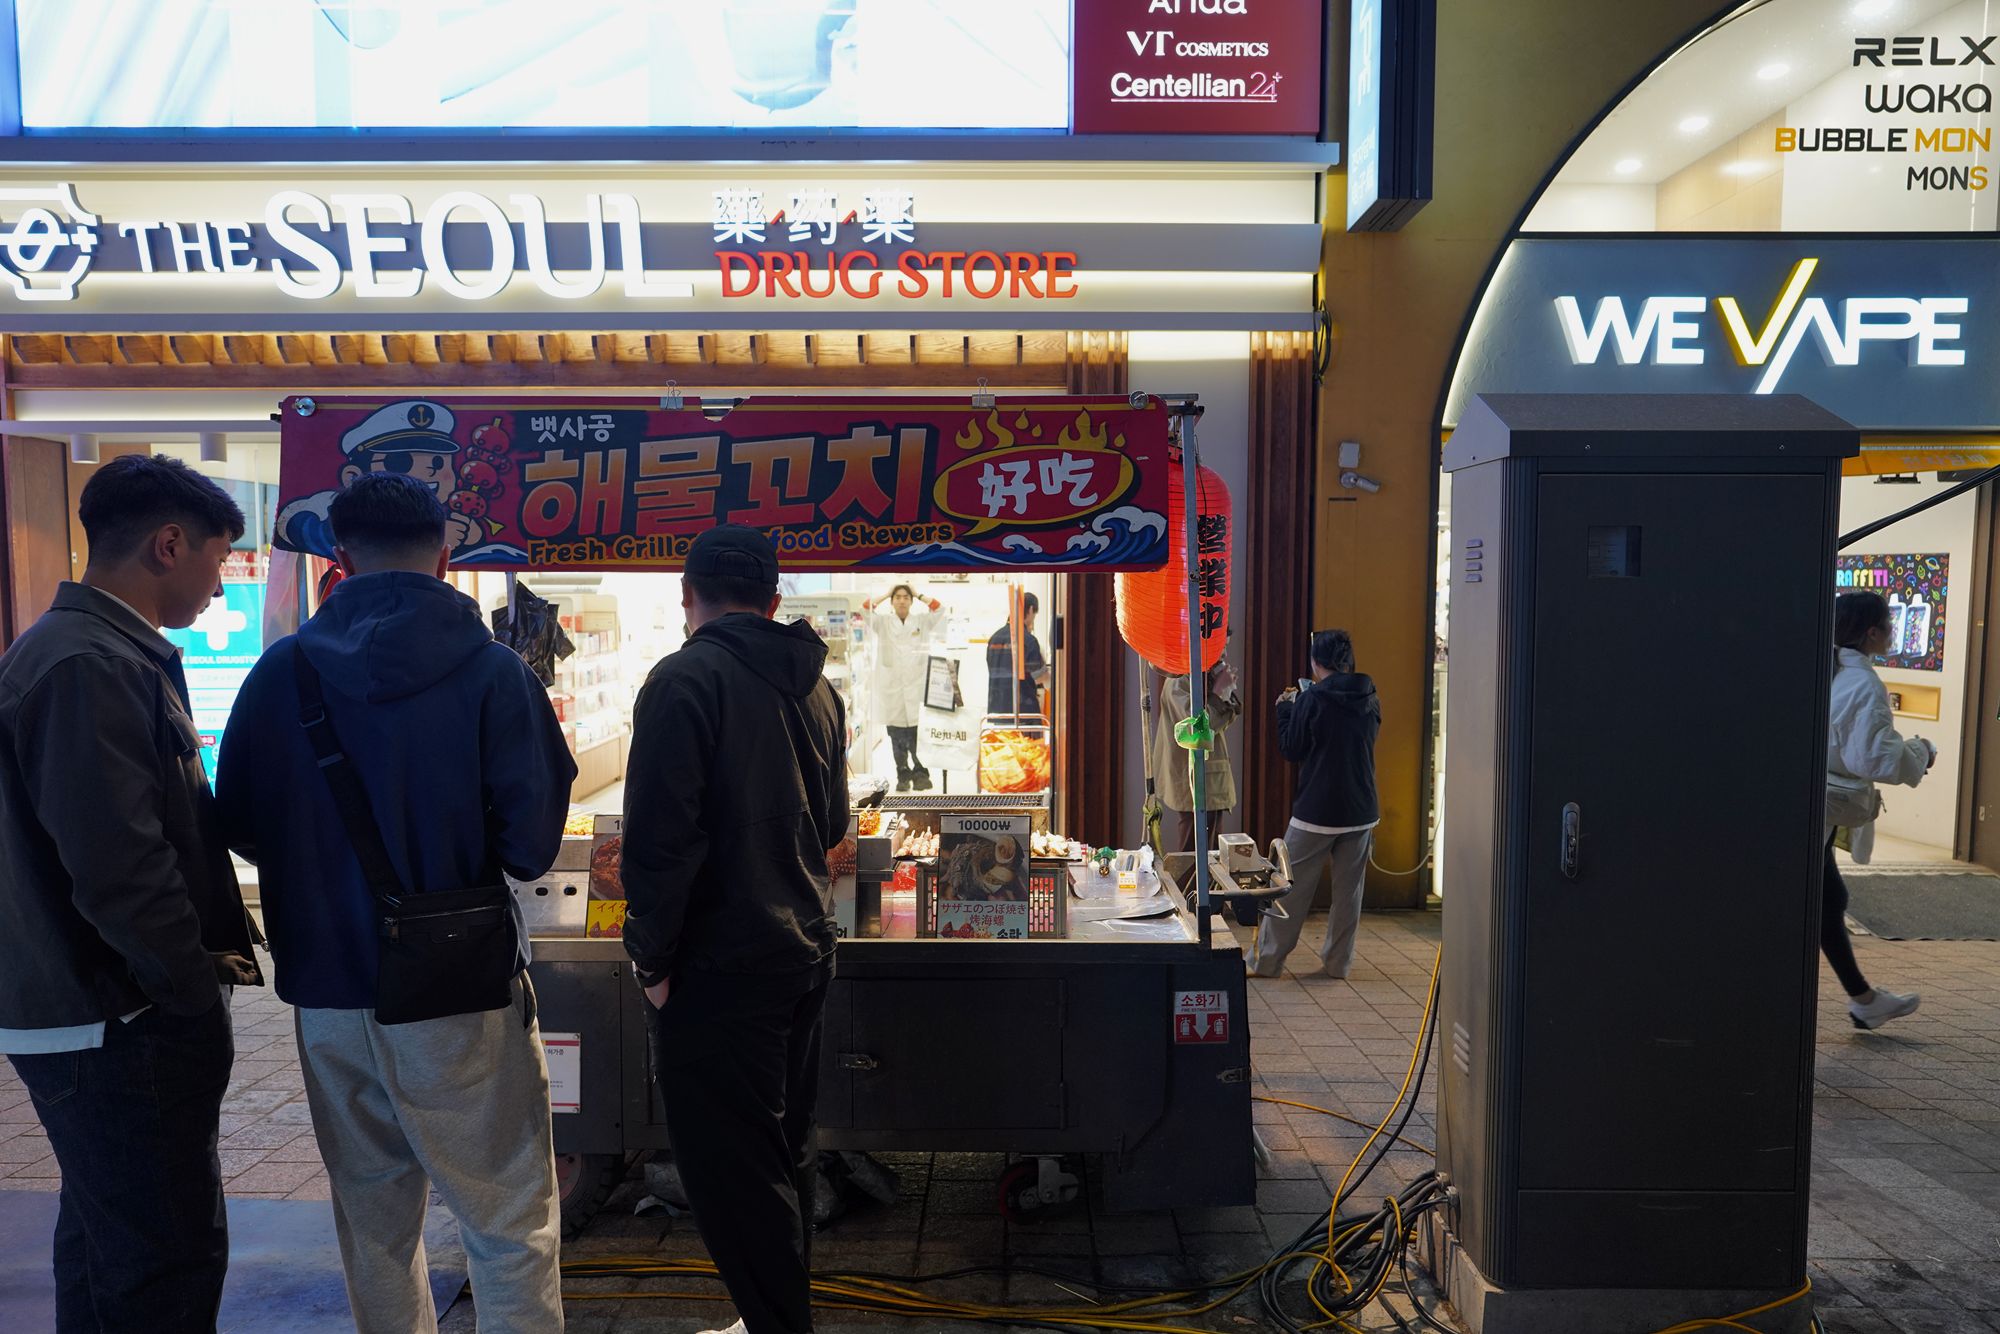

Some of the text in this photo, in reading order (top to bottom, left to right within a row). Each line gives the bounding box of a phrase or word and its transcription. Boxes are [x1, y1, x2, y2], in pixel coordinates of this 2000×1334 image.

[1126, 31, 1269, 57] VT COSMETICS
[1852, 36, 1998, 67] RELX
[1775, 127, 1992, 153] BUBBLE MON
[1907, 166, 1989, 192] MONS
[118, 191, 694, 300] THE SEOUL
[714, 250, 1079, 299] DRUG STORE
[1553, 257, 1970, 394] WE VAPE
[522, 425, 929, 537] 해물꼬치
[977, 452, 1099, 518] 好吃
[529, 522, 954, 565] Fresh Grille food Skewers
[1836, 569, 1889, 587] RAFFITI
[930, 727, 967, 742] Reju-All
[940, 903, 1027, 915] サザエのつぼ焼き
[969, 914, 1005, 927] 烤海螺
[1181, 993, 1220, 1007] 소화기
